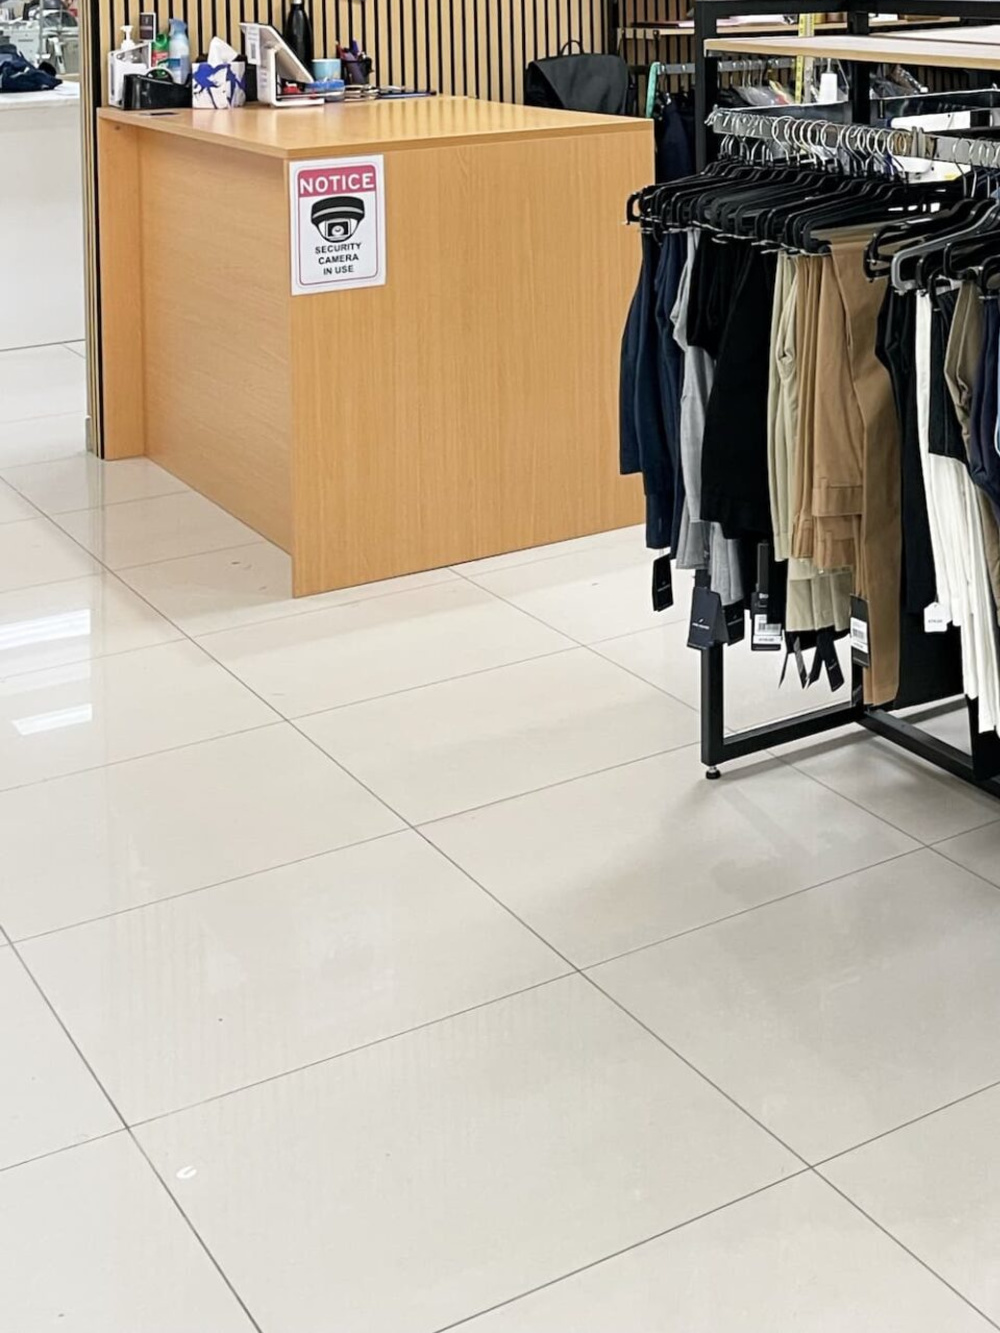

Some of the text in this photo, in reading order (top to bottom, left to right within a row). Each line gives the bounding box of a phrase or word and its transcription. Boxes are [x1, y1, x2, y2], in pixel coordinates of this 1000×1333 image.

[299, 172, 375, 195] NOTICE
[315, 242, 361, 254] SECURITY
[318, 253, 359, 265] CAMERA
[323, 265, 354, 276] IN USE
